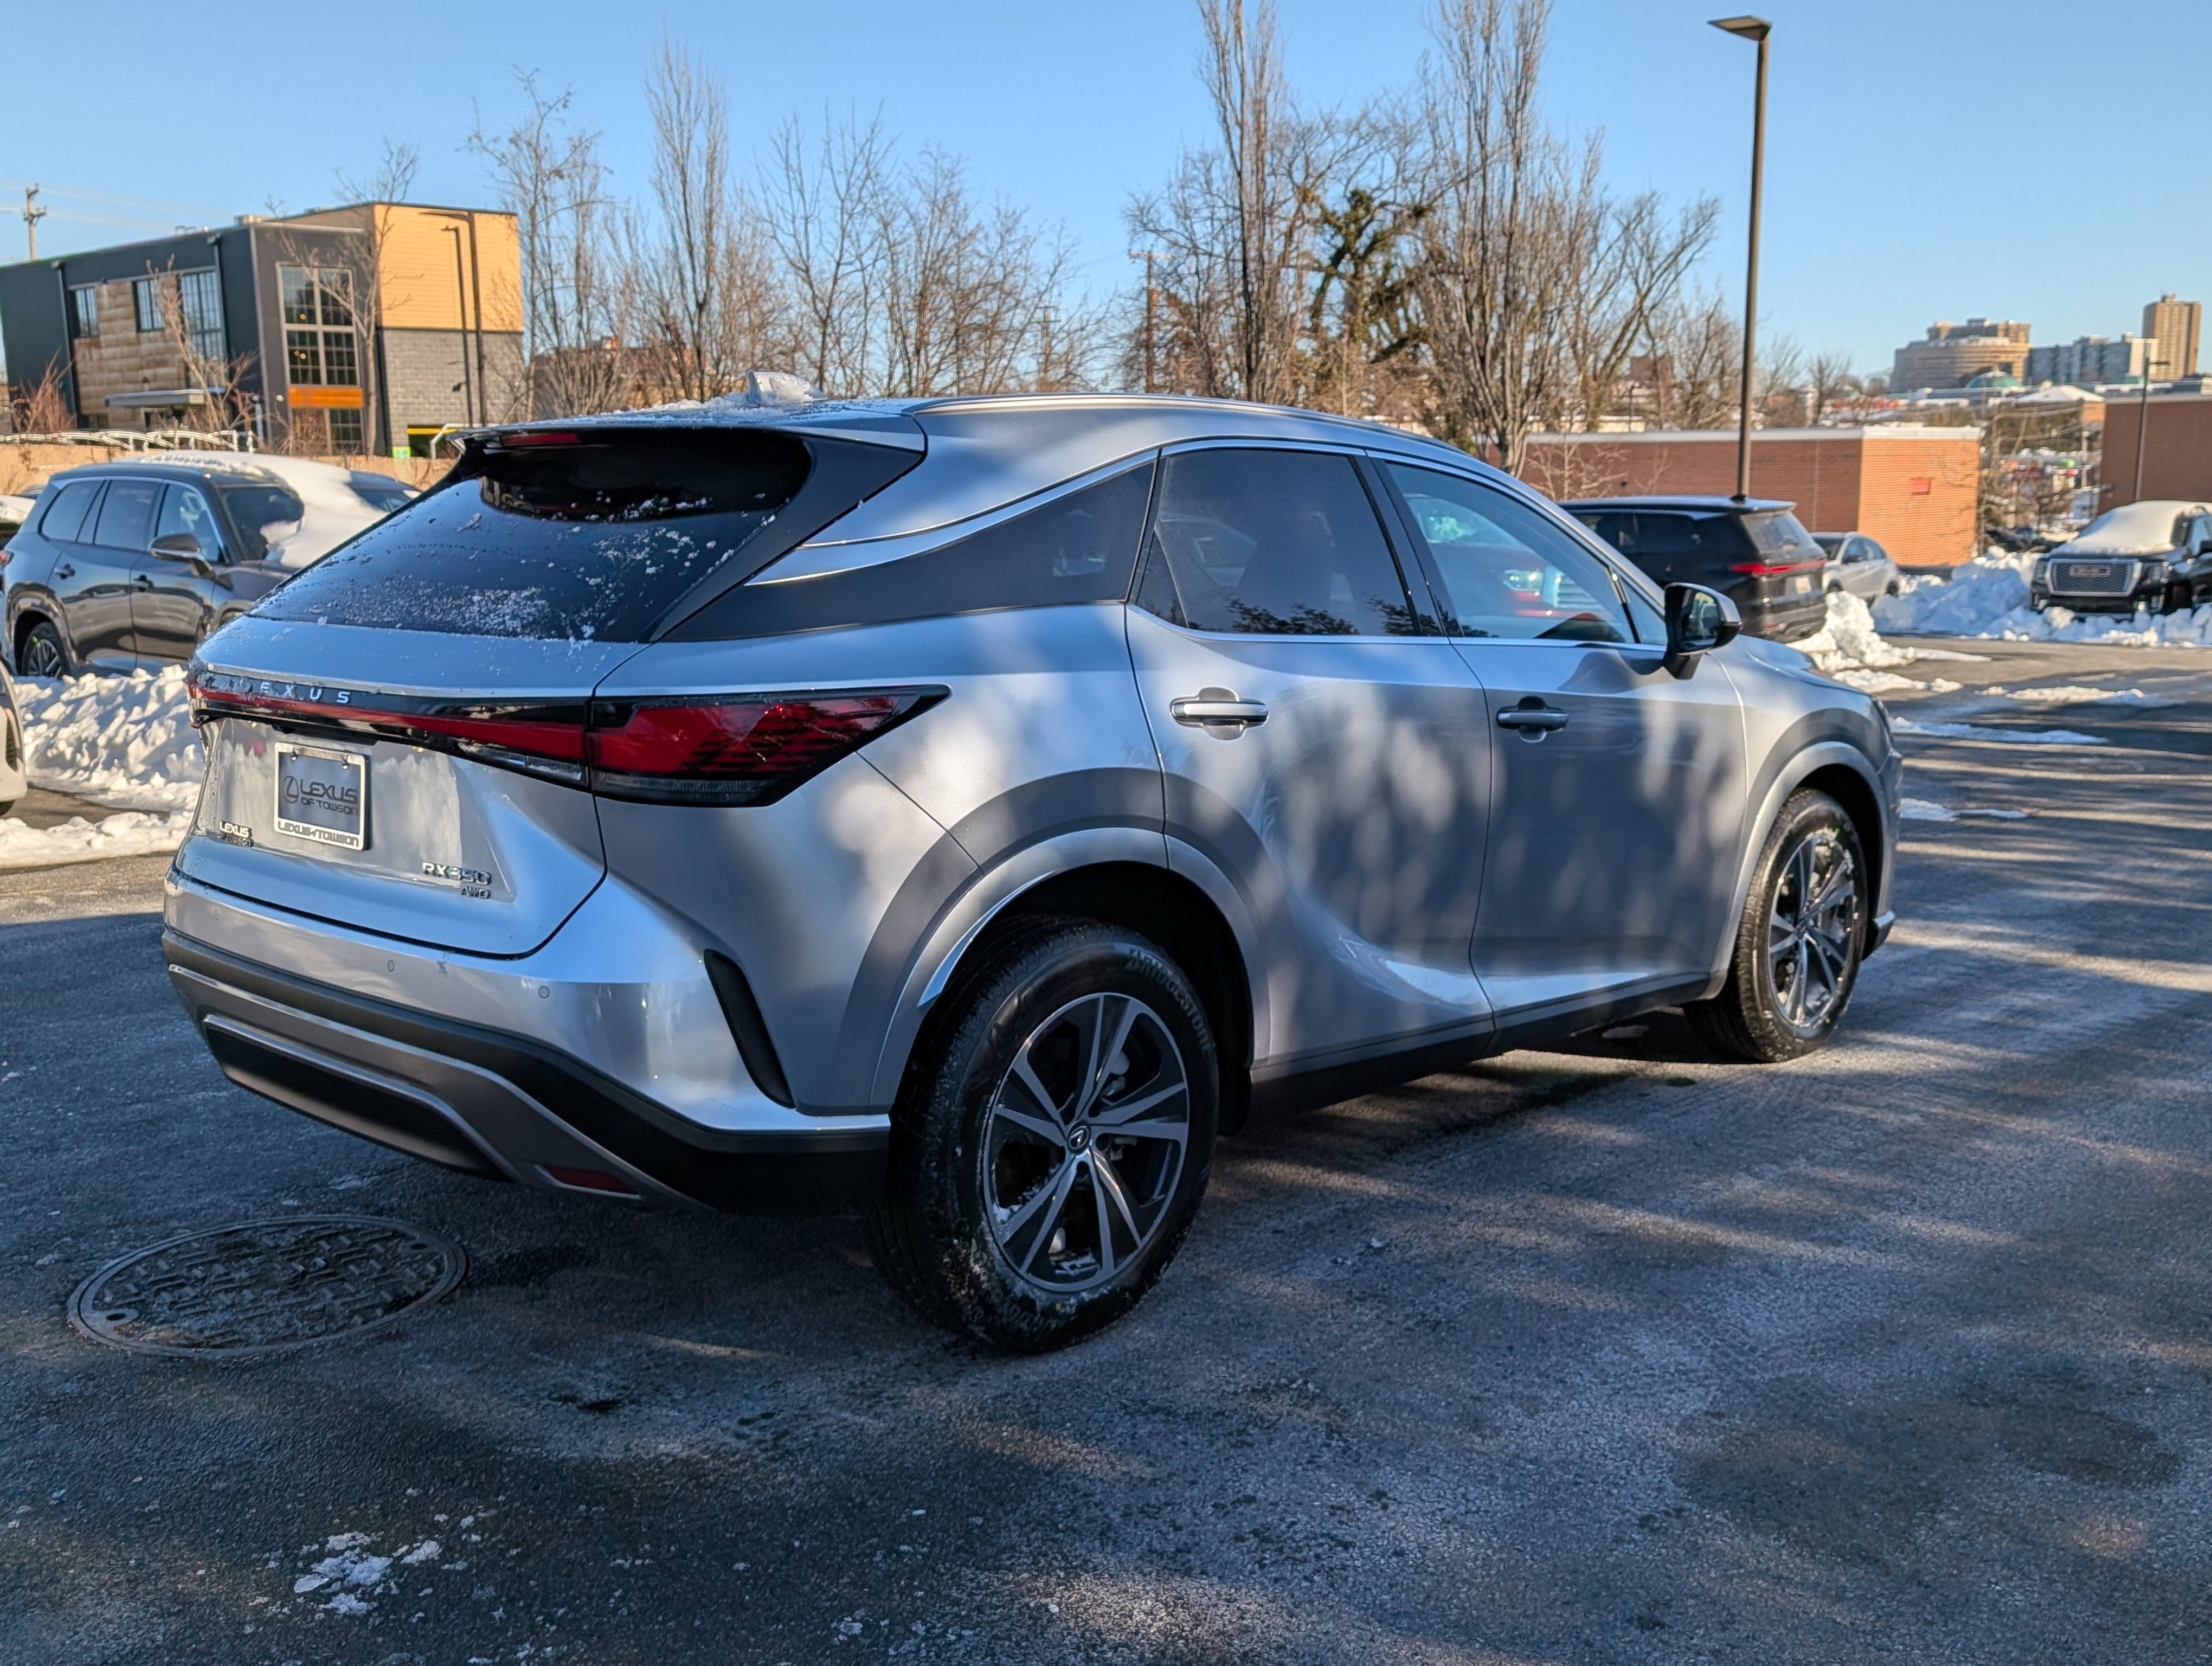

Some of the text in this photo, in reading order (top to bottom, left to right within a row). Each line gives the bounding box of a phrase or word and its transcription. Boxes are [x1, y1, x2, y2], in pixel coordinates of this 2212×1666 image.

[300, 779, 358, 804] LEXUS
[300, 797, 315, 806] OF
[220, 821, 250, 838] LEXUS
[278, 821, 311, 836] LEXUS
[461, 886, 491, 899] AWD
